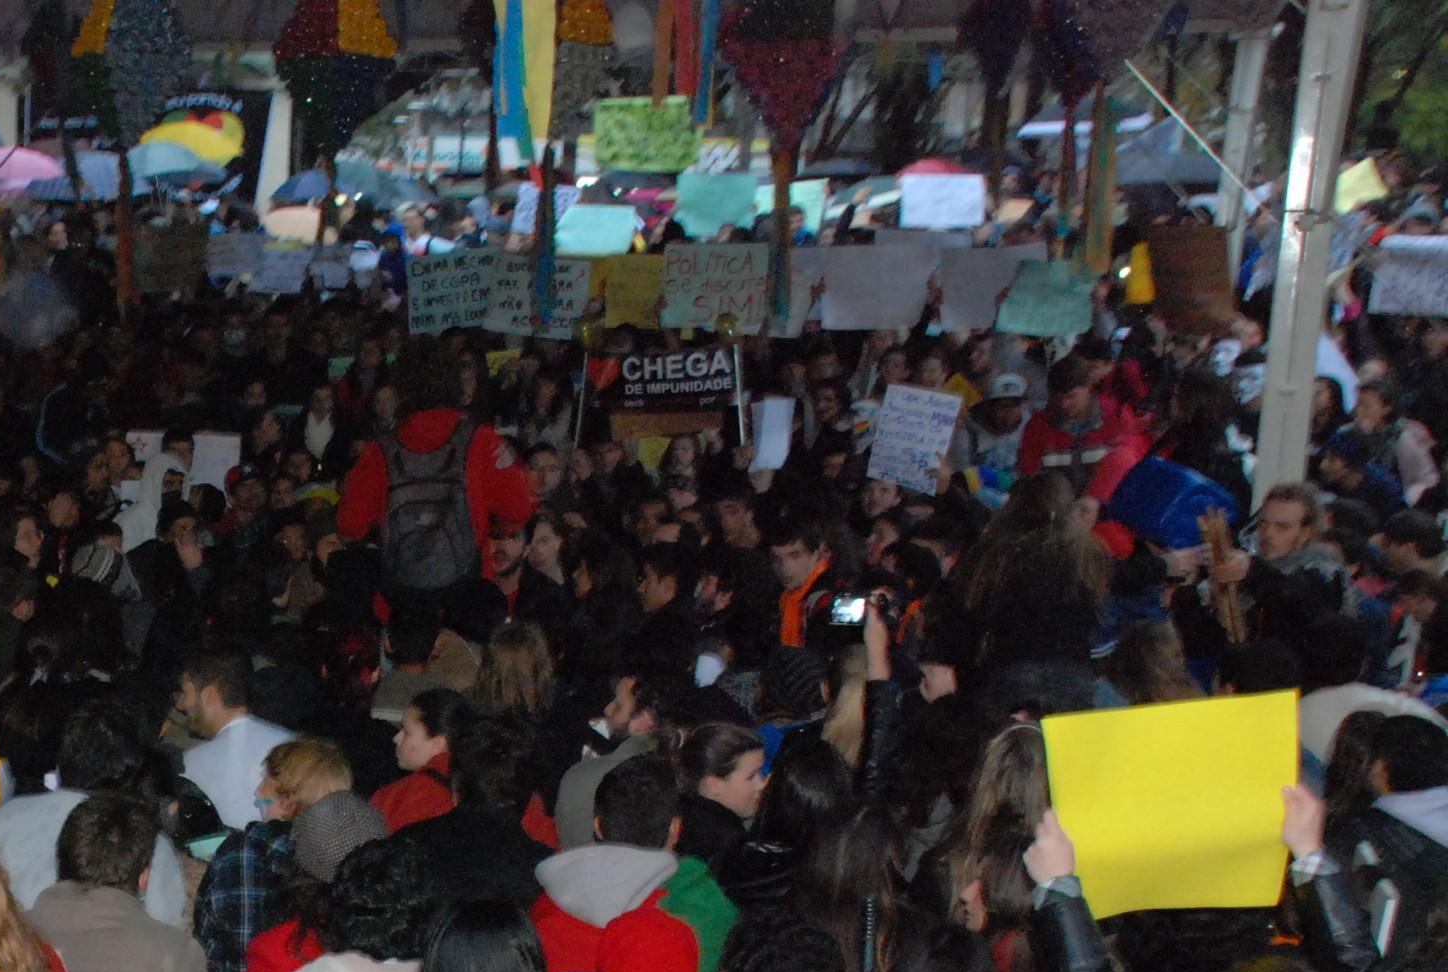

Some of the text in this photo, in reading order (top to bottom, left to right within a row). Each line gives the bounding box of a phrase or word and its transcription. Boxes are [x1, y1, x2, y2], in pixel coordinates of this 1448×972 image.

[622, 350, 730, 381] CHEGA
[625, 376, 733, 395] DE IMPUNIDADE
